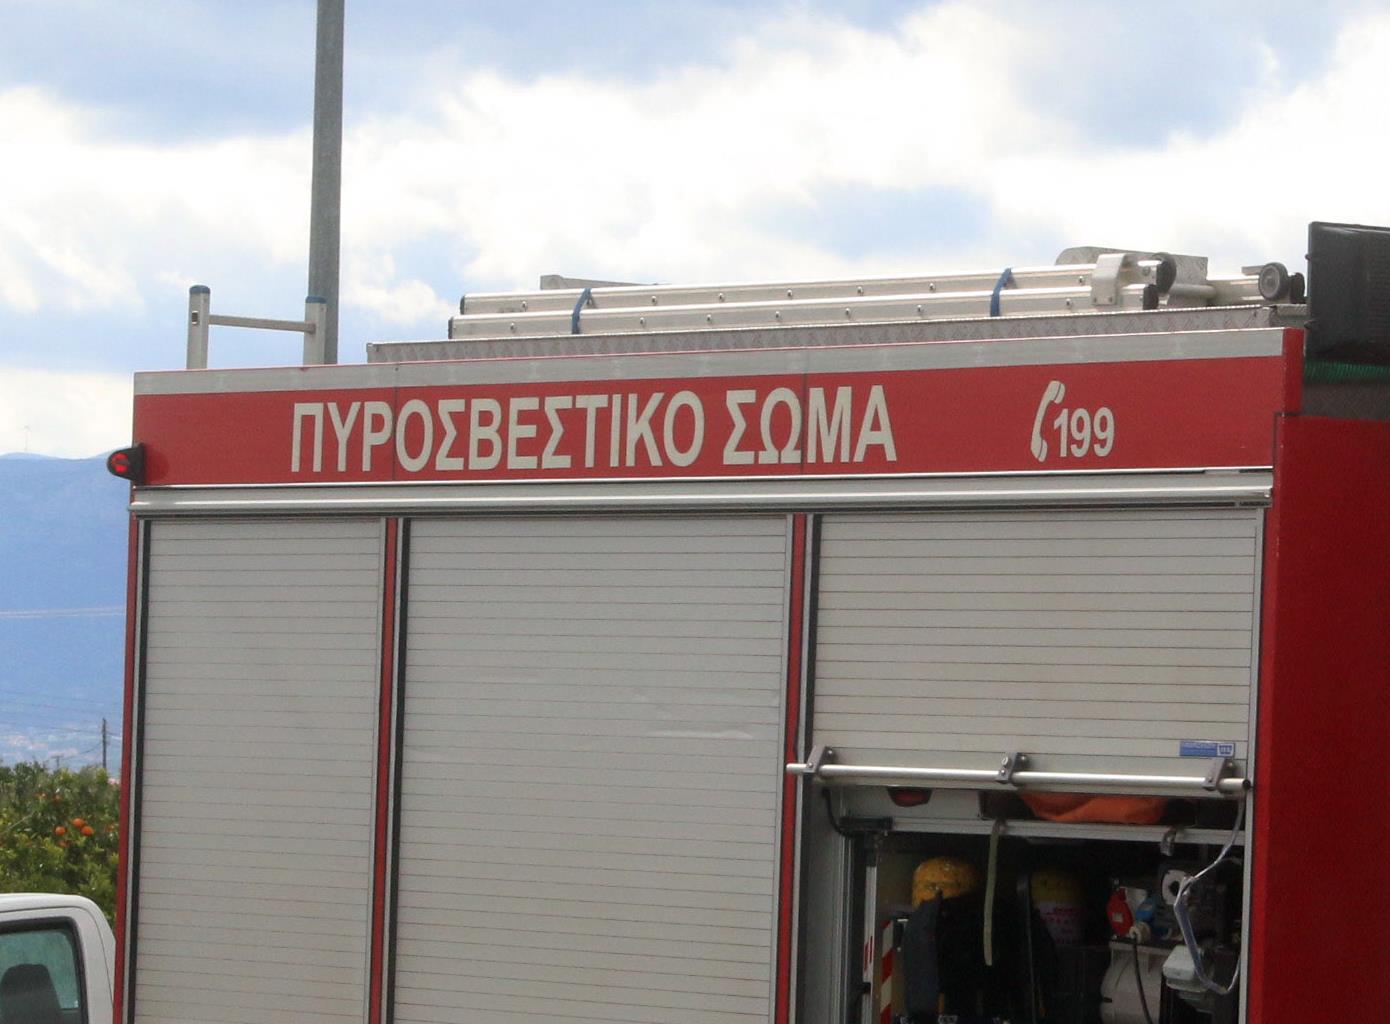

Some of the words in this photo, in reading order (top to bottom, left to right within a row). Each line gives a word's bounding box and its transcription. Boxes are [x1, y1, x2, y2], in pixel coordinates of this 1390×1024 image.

[291, 390, 705, 474] ΠΥΡΟΣΒΕΣΤΙΚΟ
[722, 383, 898, 466] ΣΩΜΑ
[1053, 405, 1115, 458] 199
